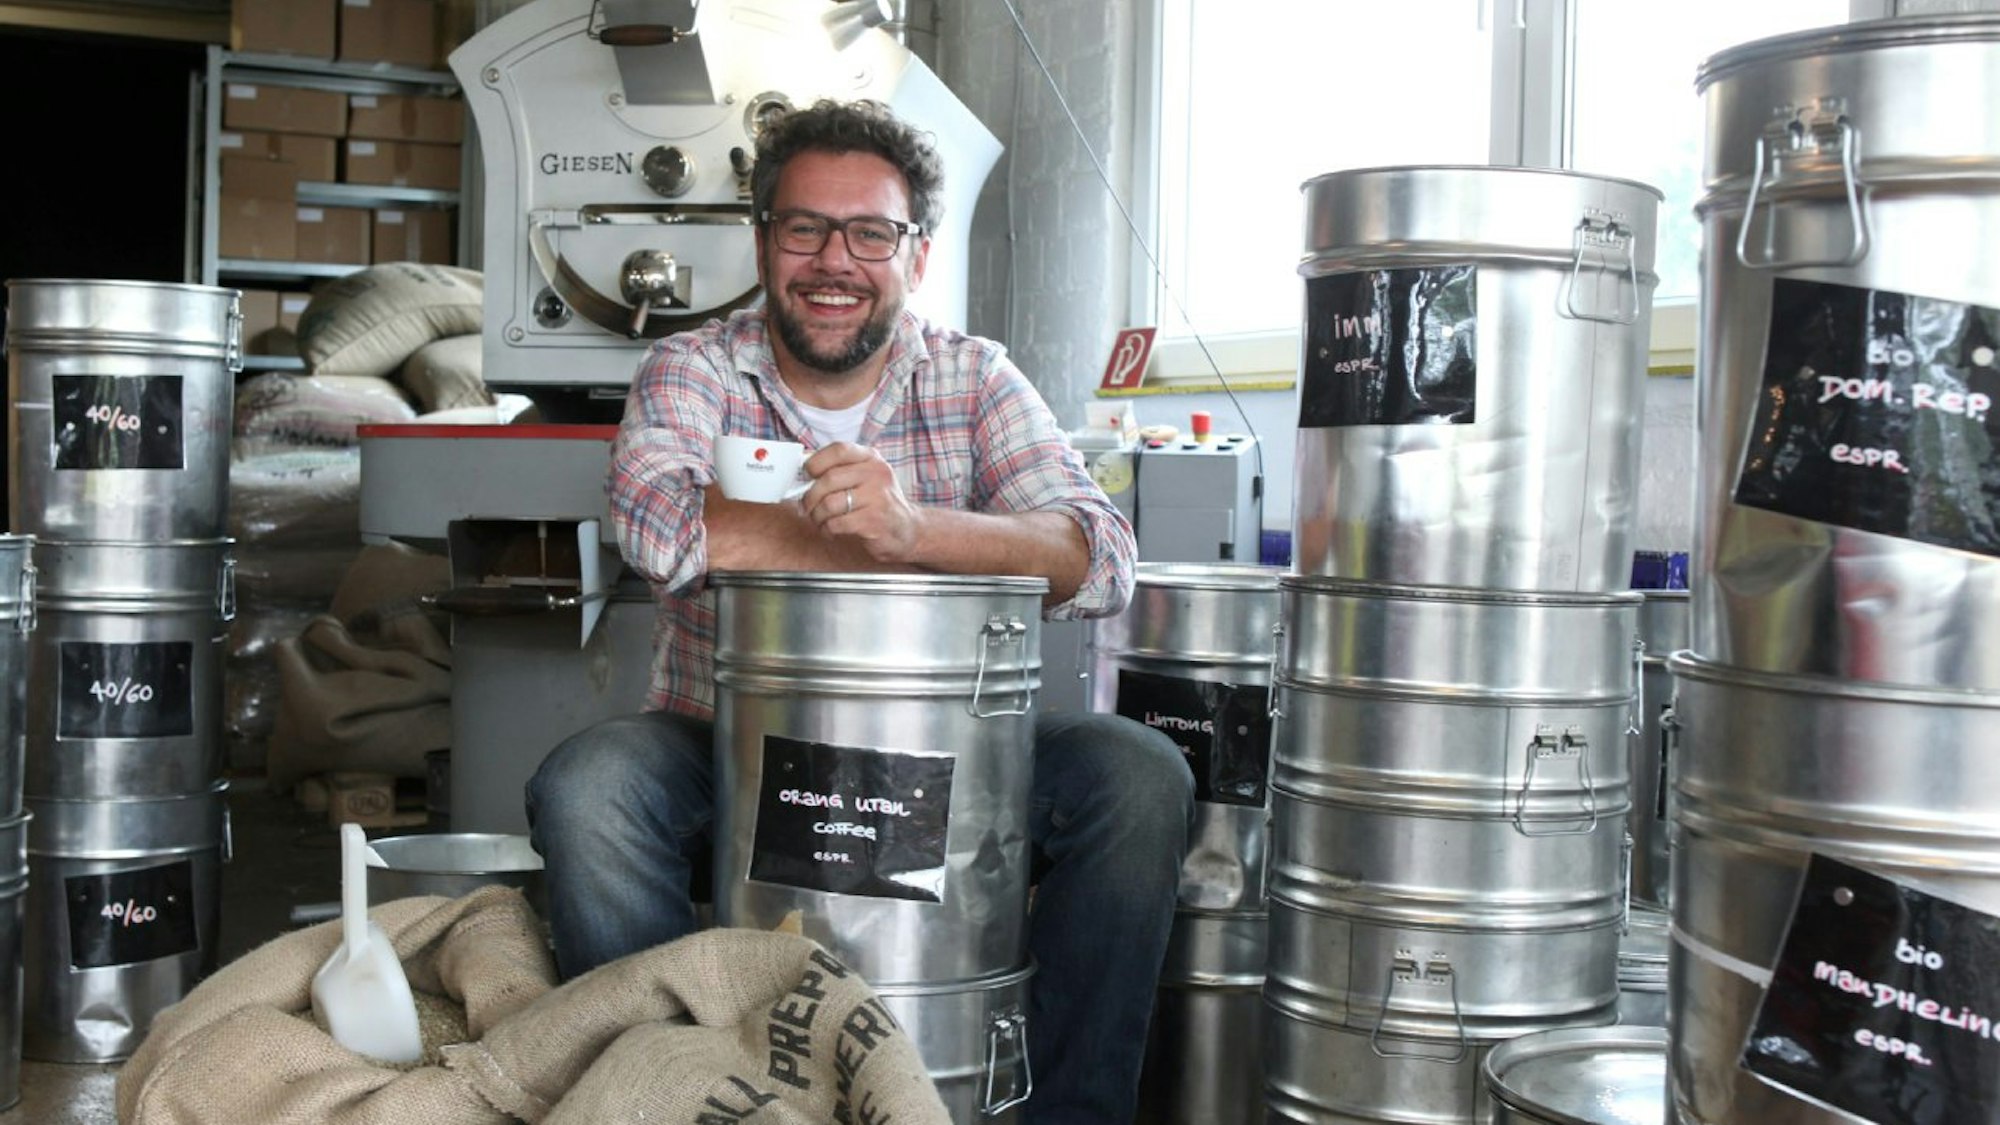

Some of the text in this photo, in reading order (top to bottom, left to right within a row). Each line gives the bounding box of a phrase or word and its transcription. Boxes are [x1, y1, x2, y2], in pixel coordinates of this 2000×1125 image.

[540, 152, 633, 175] GIESEN
[85, 404, 141, 432] 40/60
[89, 677, 153, 705] 40/60
[100, 899, 157, 928] 40/60
[1895, 937, 1943, 970] bio
